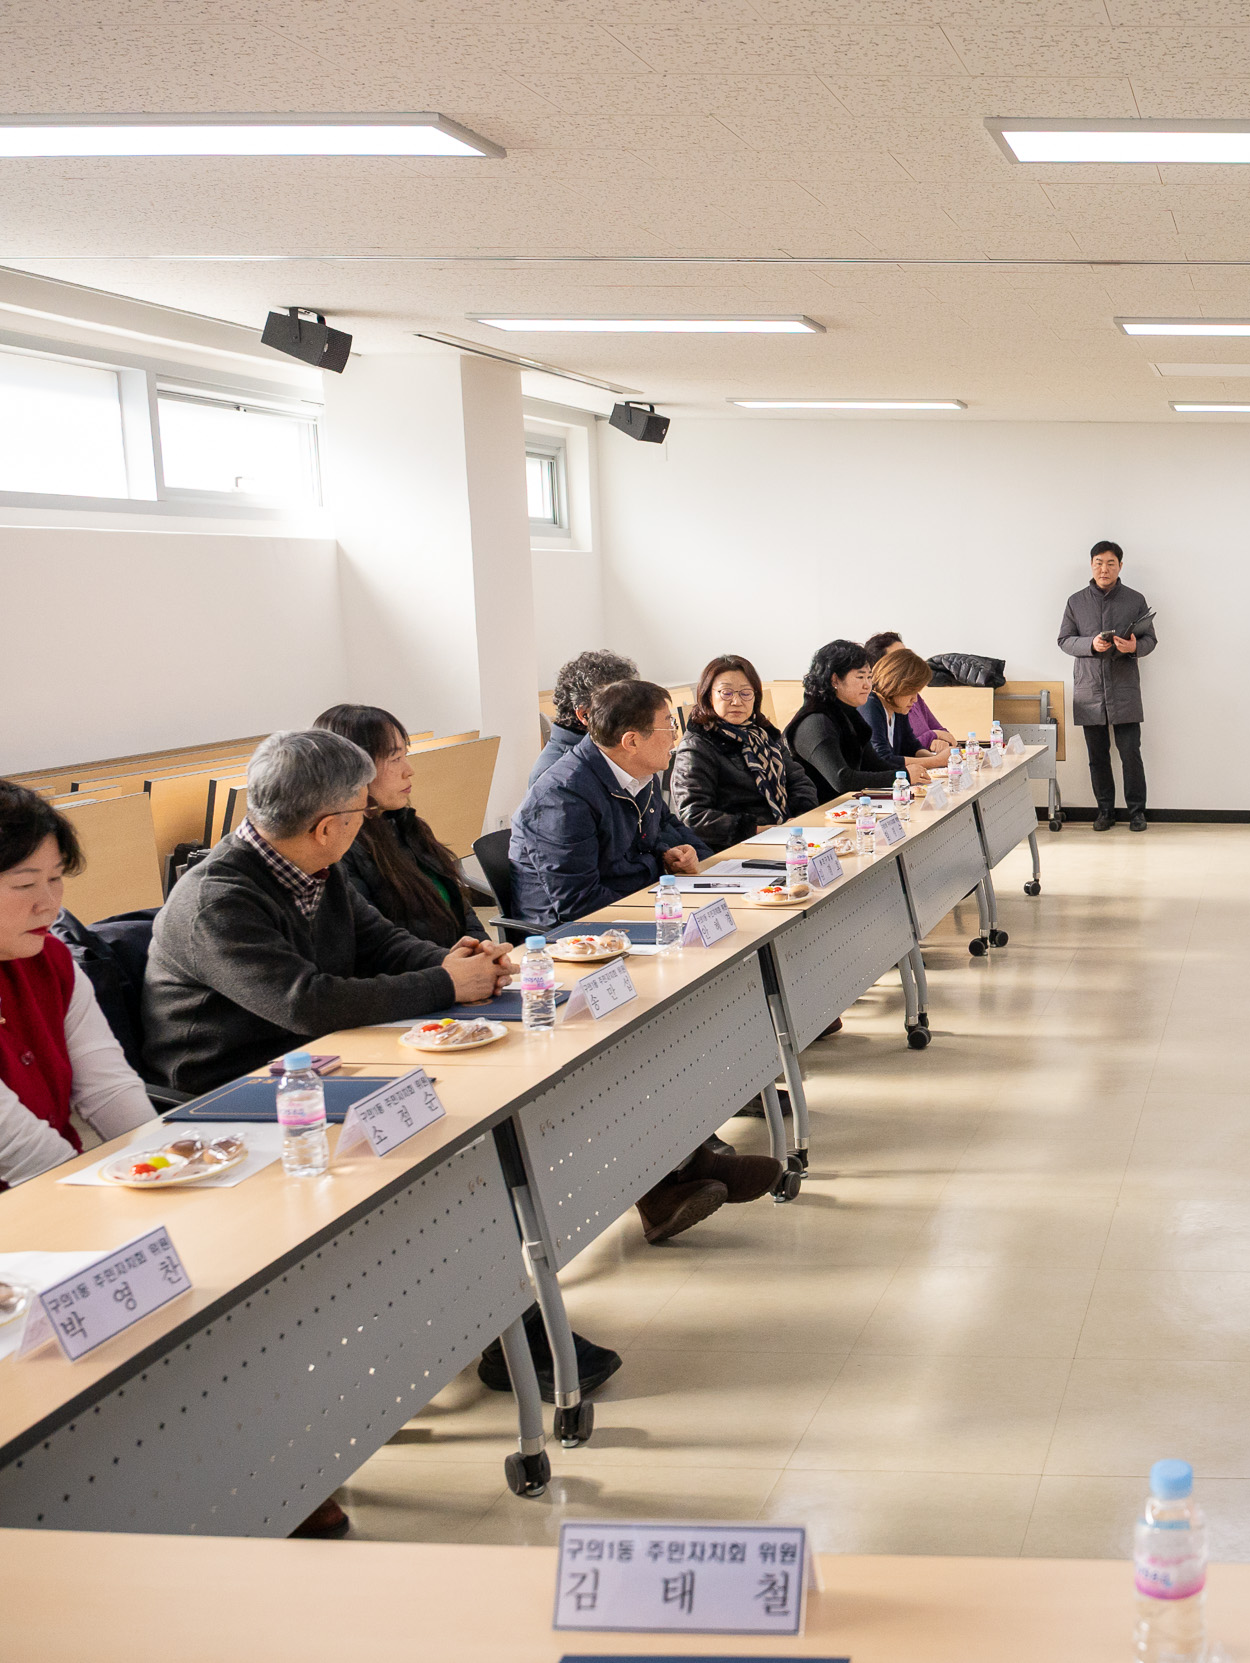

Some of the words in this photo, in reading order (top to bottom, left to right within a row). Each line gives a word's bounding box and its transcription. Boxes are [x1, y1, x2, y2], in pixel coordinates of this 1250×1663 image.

[359, 1104, 385, 1123] 구의1동
[415, 1076, 429, 1090] 위원
[48, 1282, 90, 1314] 구의1동
[148, 1237, 172, 1256] 위원
[60, 1311, 88, 1339] 박
[112, 1281, 138, 1311] 영
[159, 1255, 183, 1285] 찬
[566, 1538, 635, 1563] 구의1동
[758, 1541, 798, 1566] 위원
[565, 1567, 601, 1612] 김
[662, 1568, 696, 1615] 태
[754, 1569, 791, 1617] 철
